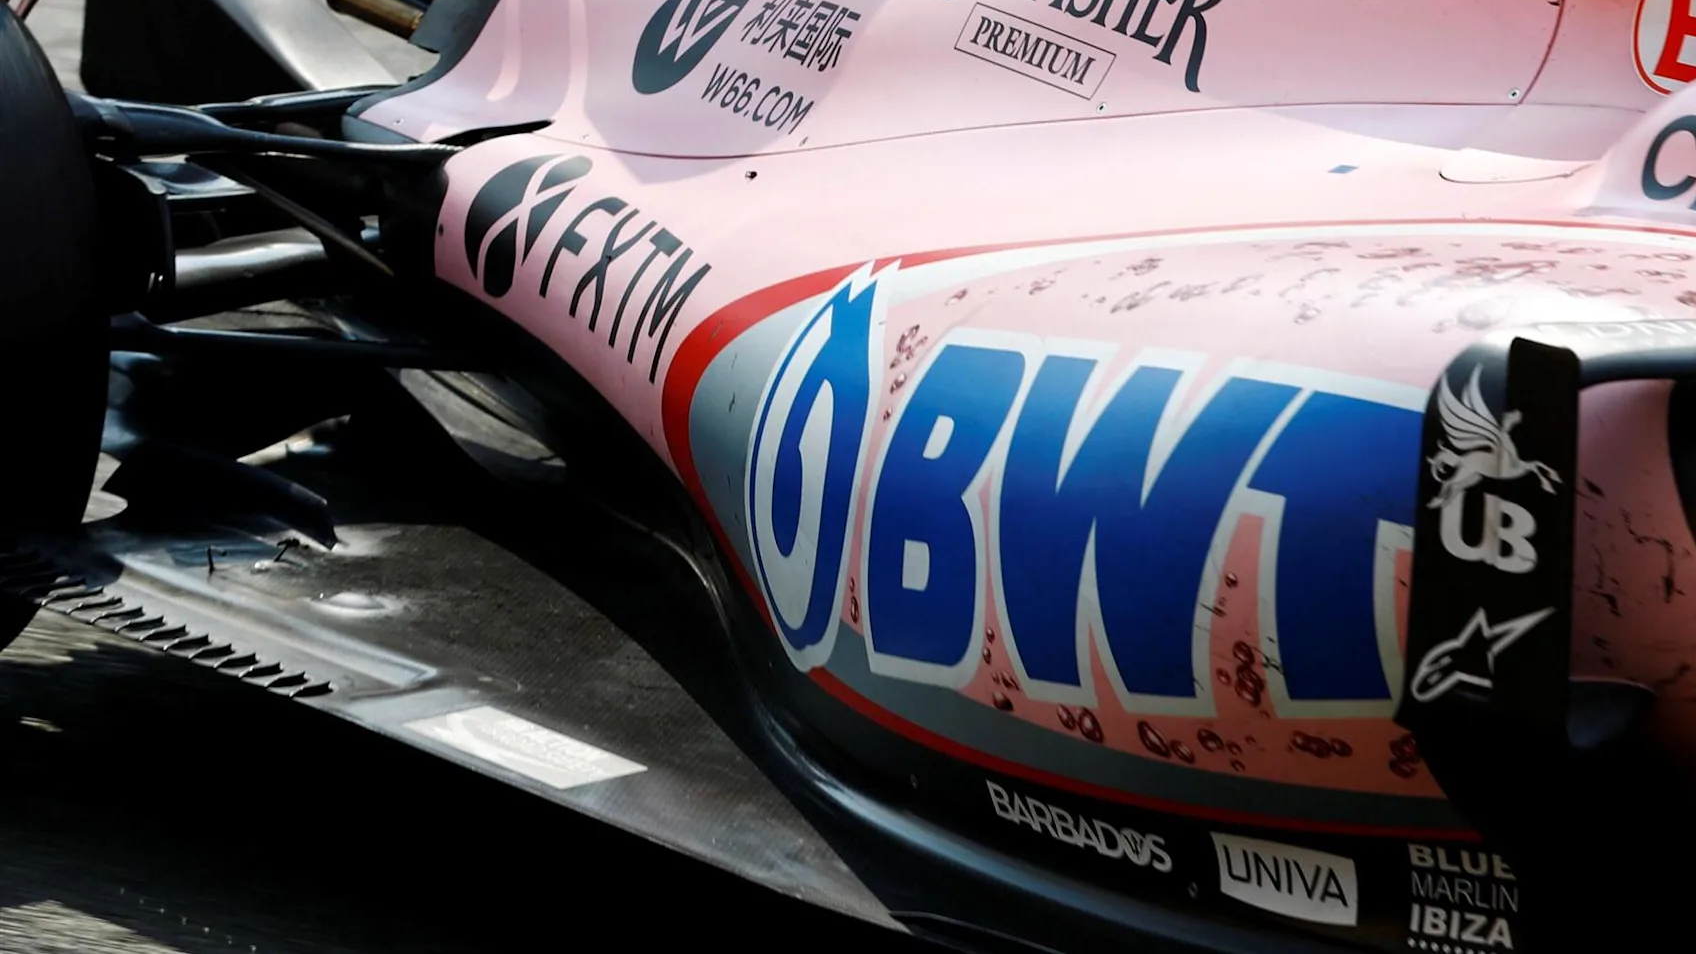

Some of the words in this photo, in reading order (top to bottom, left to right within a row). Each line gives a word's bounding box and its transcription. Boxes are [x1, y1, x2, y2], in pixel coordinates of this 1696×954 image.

[969, 16, 1098, 87] PREMIUM
[702, 63, 812, 138] W66.COM
[540, 196, 711, 385] FXTM
[867, 342, 1424, 702] BWT
[986, 778, 1172, 873] BARBADOS
[1225, 838, 1349, 908] UNIVA
[1407, 844, 1516, 881] BLUE
[1411, 872, 1519, 914] MARLIN
[1409, 905, 1513, 948] IBIZA
